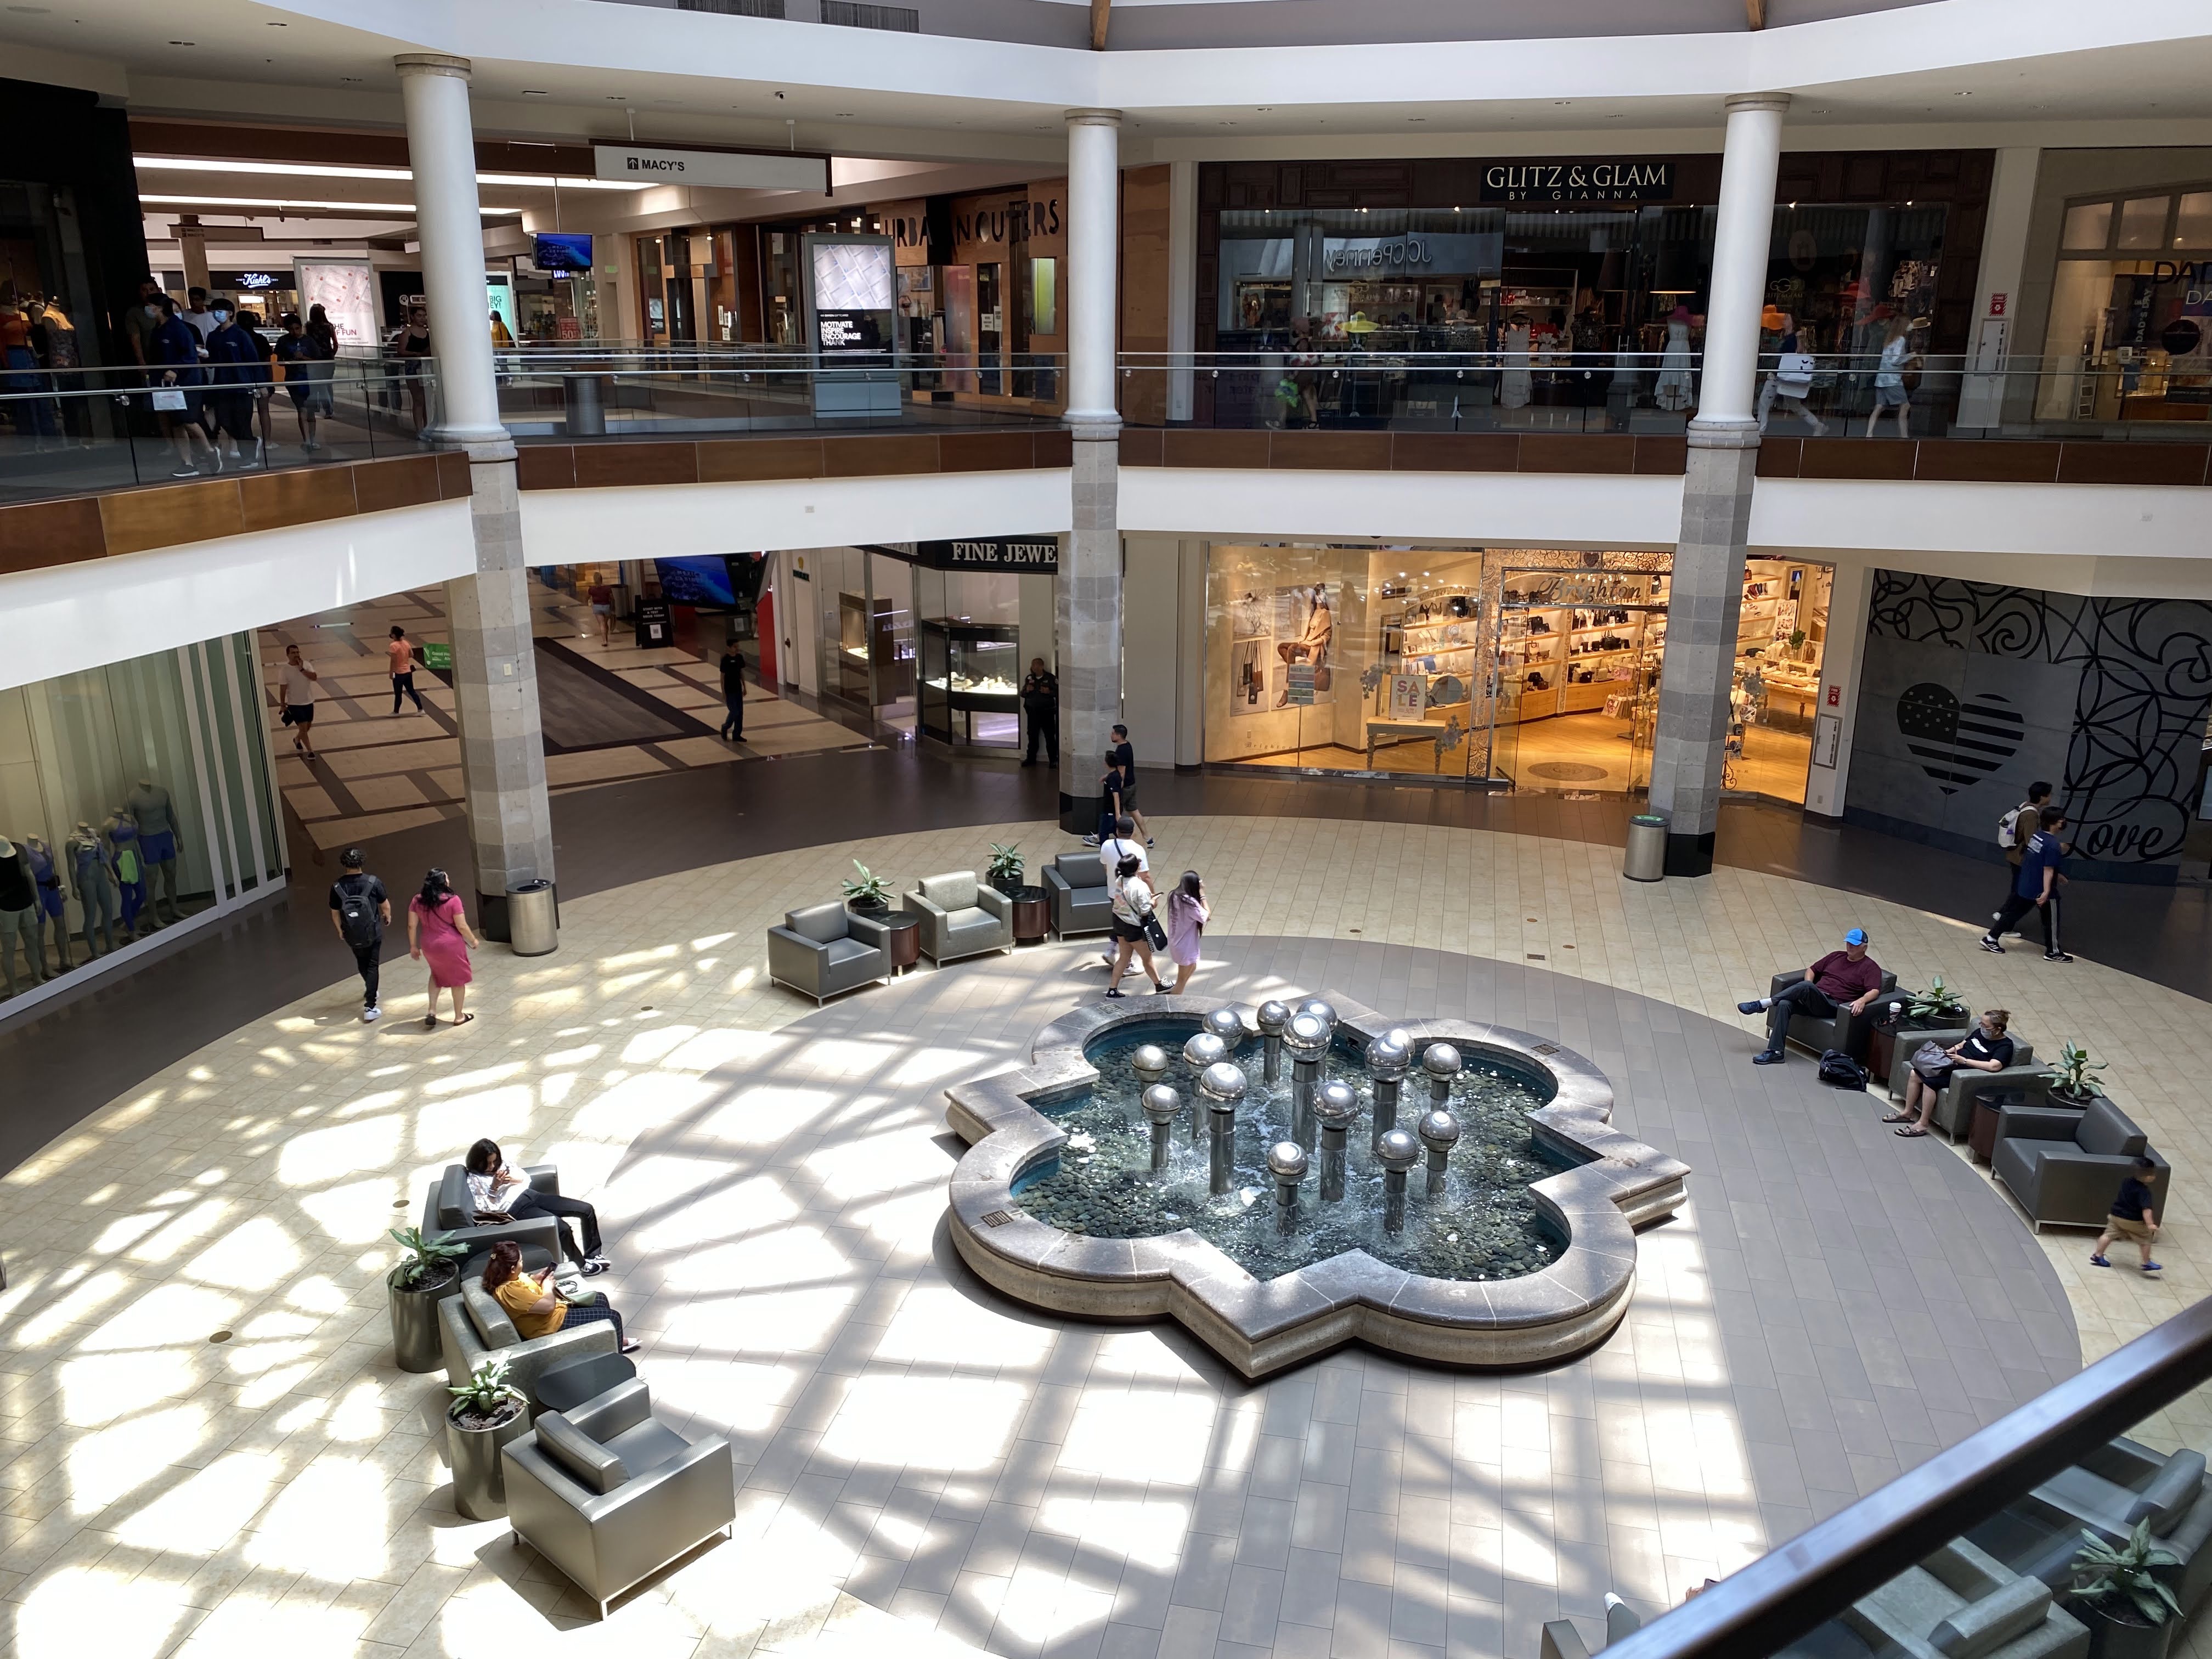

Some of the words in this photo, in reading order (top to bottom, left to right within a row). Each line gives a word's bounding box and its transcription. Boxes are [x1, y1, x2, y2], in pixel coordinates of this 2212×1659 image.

[641, 159, 685, 171] MACY'S
[1487, 166, 1562, 188] GLITZ
[1568, 166, 1589, 187] &
[1593, 164, 1667, 187] GLAM
[1509, 191, 1527, 200] BY
[1552, 190, 1638, 200] GIANNA
[243, 273, 273, 289] Kiehl's
[951, 541, 998, 562] FINE
[1003, 544, 1058, 563] JEWE
[1538, 577, 1641, 603] Brighton
